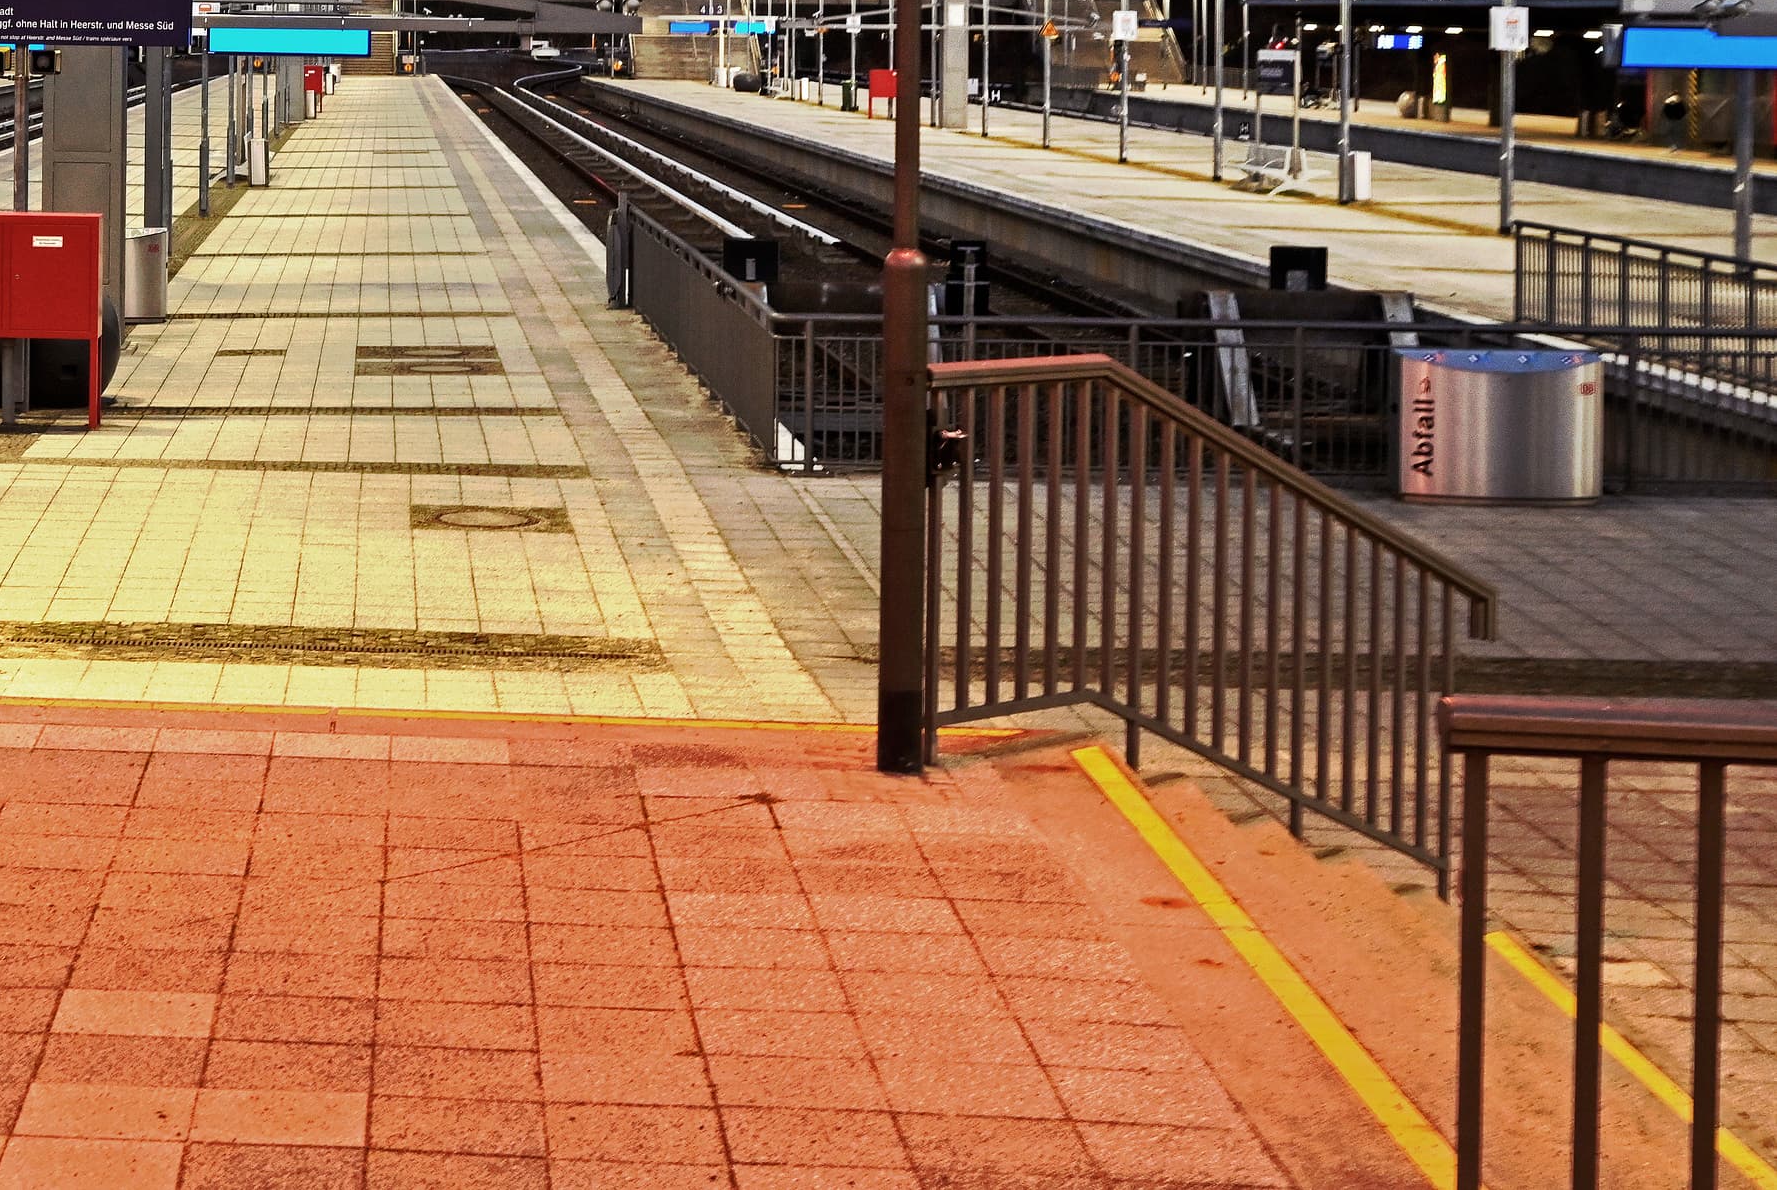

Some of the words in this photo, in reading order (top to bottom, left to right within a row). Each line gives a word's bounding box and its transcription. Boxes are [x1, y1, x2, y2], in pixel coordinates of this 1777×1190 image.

[717, 5, 723, 14] 3
[15, 19, 38, 28] ohne
[40, 19, 58, 29] Halt
[60, 19, 69, 29] in
[70, 20, 105, 30] Heerstr.
[107, 20, 124, 30] und
[125, 21, 155, 30] Messe
[156, 21, 174, 30] Süd
[991, 89, 1001, 102] H
[1411, 398, 1435, 477] Abfall
